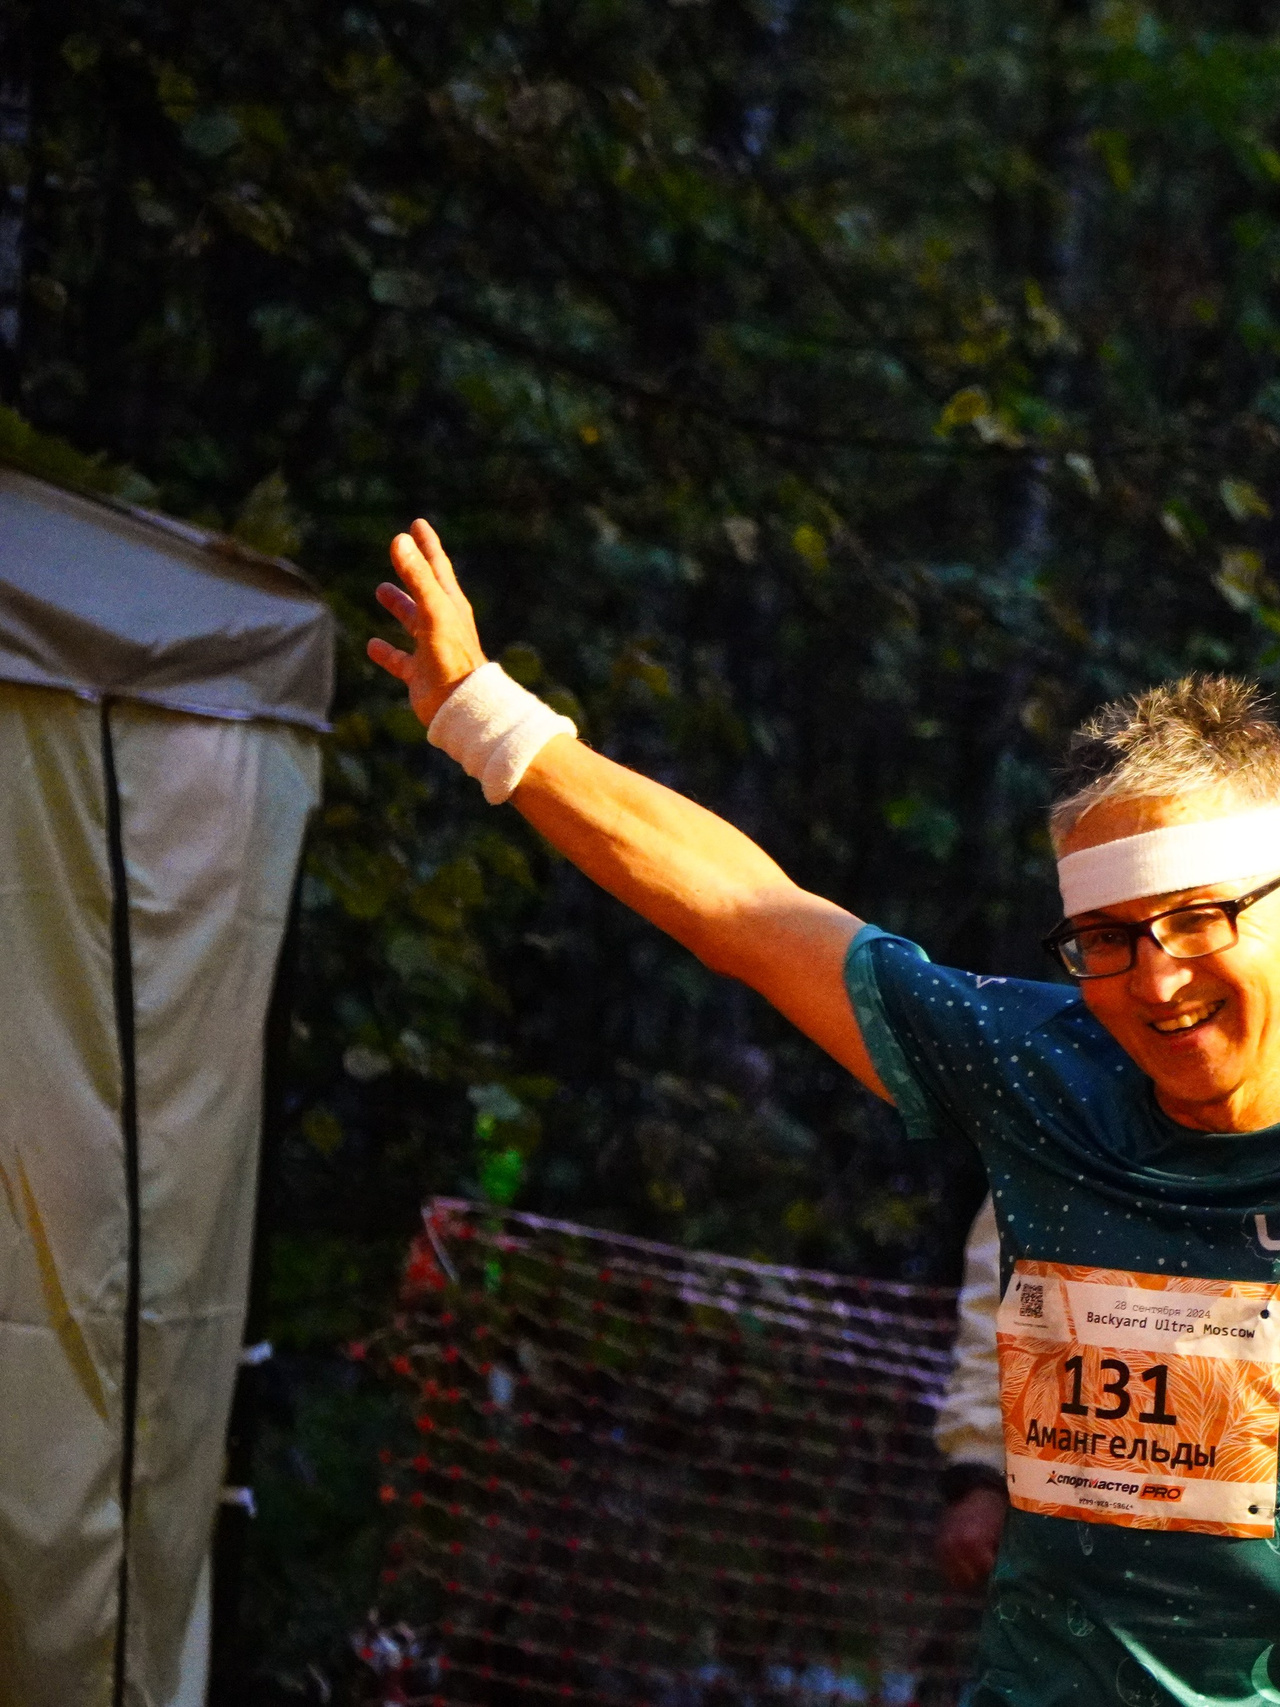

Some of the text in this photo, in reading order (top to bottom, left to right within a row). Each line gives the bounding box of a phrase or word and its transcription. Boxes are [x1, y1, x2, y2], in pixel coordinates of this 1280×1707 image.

[1114, 1300, 1212, 1320] 28 сентября 2024
[1086, 1311, 1256, 1339] Backyard Ultra Moscow
[1060, 1354, 1178, 1426] 131
[1026, 1418, 1216, 1470] Амангельды
[1141, 1486, 1182, 1500] PRO
